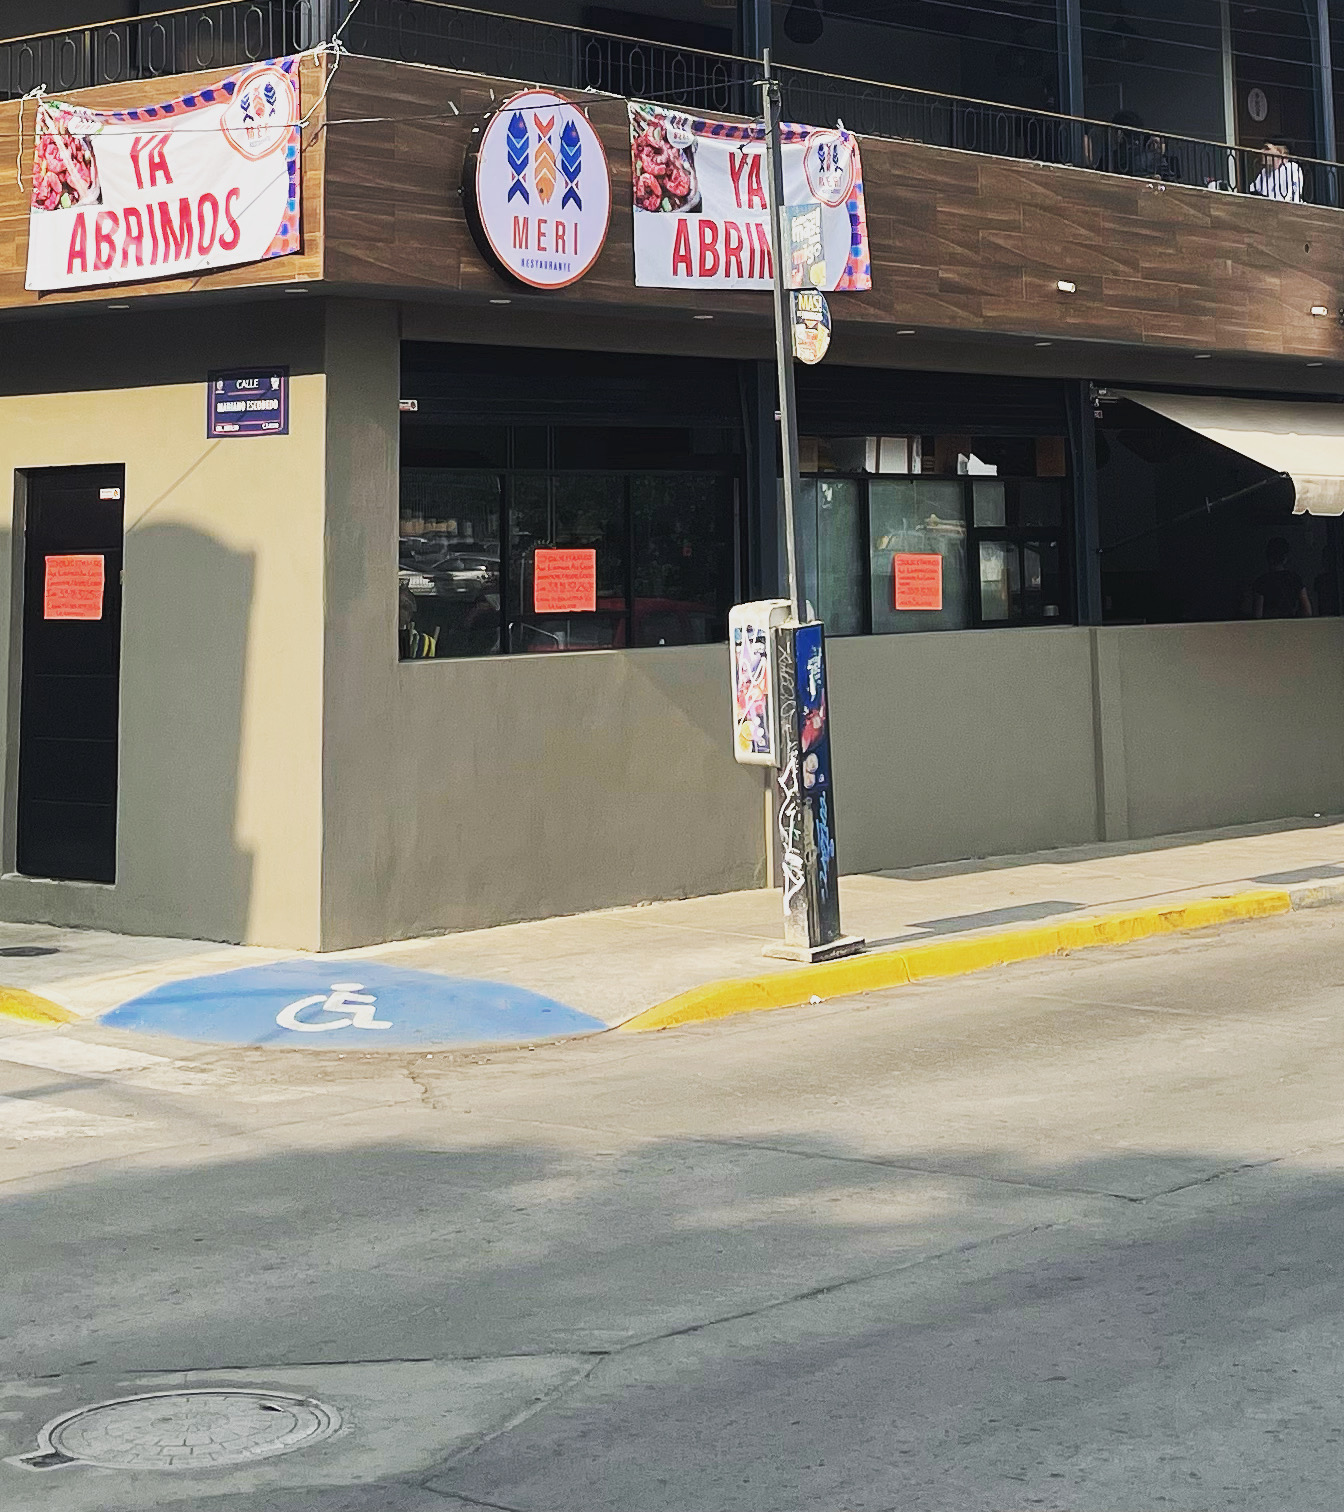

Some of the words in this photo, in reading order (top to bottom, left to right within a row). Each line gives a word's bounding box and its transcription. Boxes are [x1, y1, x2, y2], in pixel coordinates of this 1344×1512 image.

[130, 131, 174, 189] YA
[728, 151, 768, 209] YA
[66, 187, 241, 275] ABRIMOS
[512, 215, 578, 256] MERI
[672, 218, 774, 280] ABRIM
[520, 258, 571, 273] RESTAURANTE
[236, 378, 259, 389] CALLE
